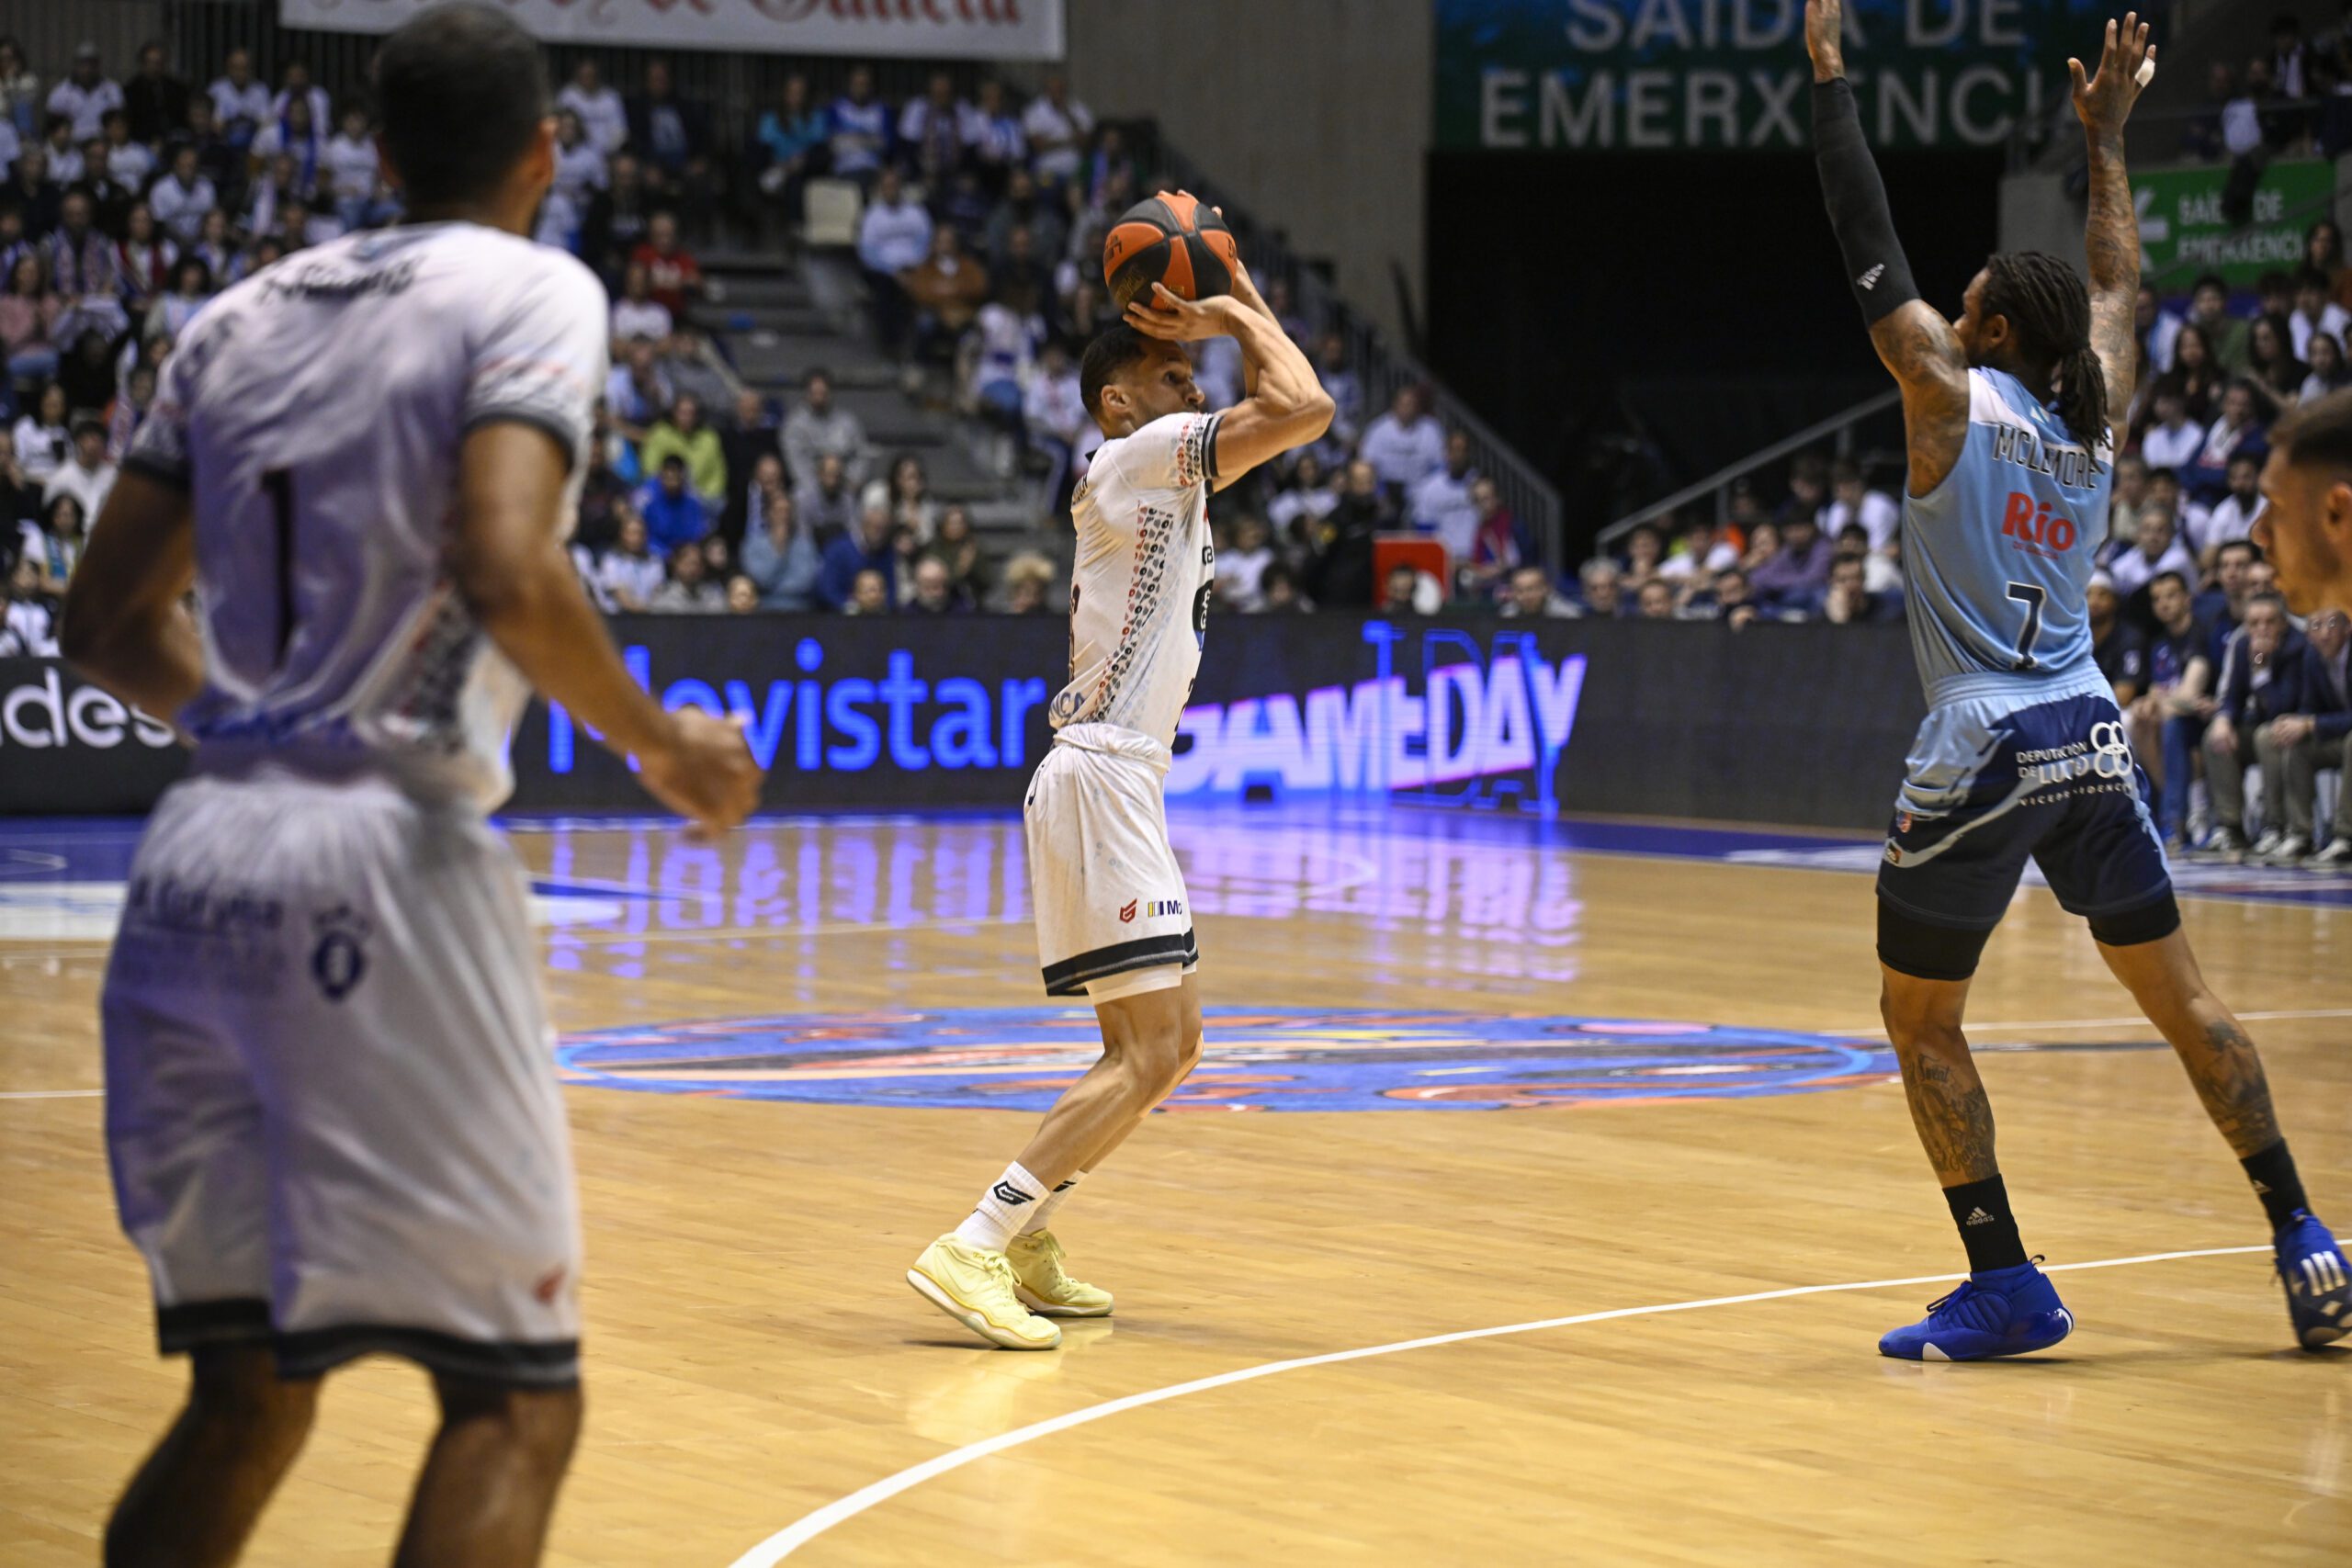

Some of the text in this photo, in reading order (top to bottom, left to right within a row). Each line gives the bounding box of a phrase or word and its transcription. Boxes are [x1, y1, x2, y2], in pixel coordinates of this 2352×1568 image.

[1905, 0, 2026, 49] DE
[2005, 581, 2047, 671] 7
[0, 665, 176, 750] des
